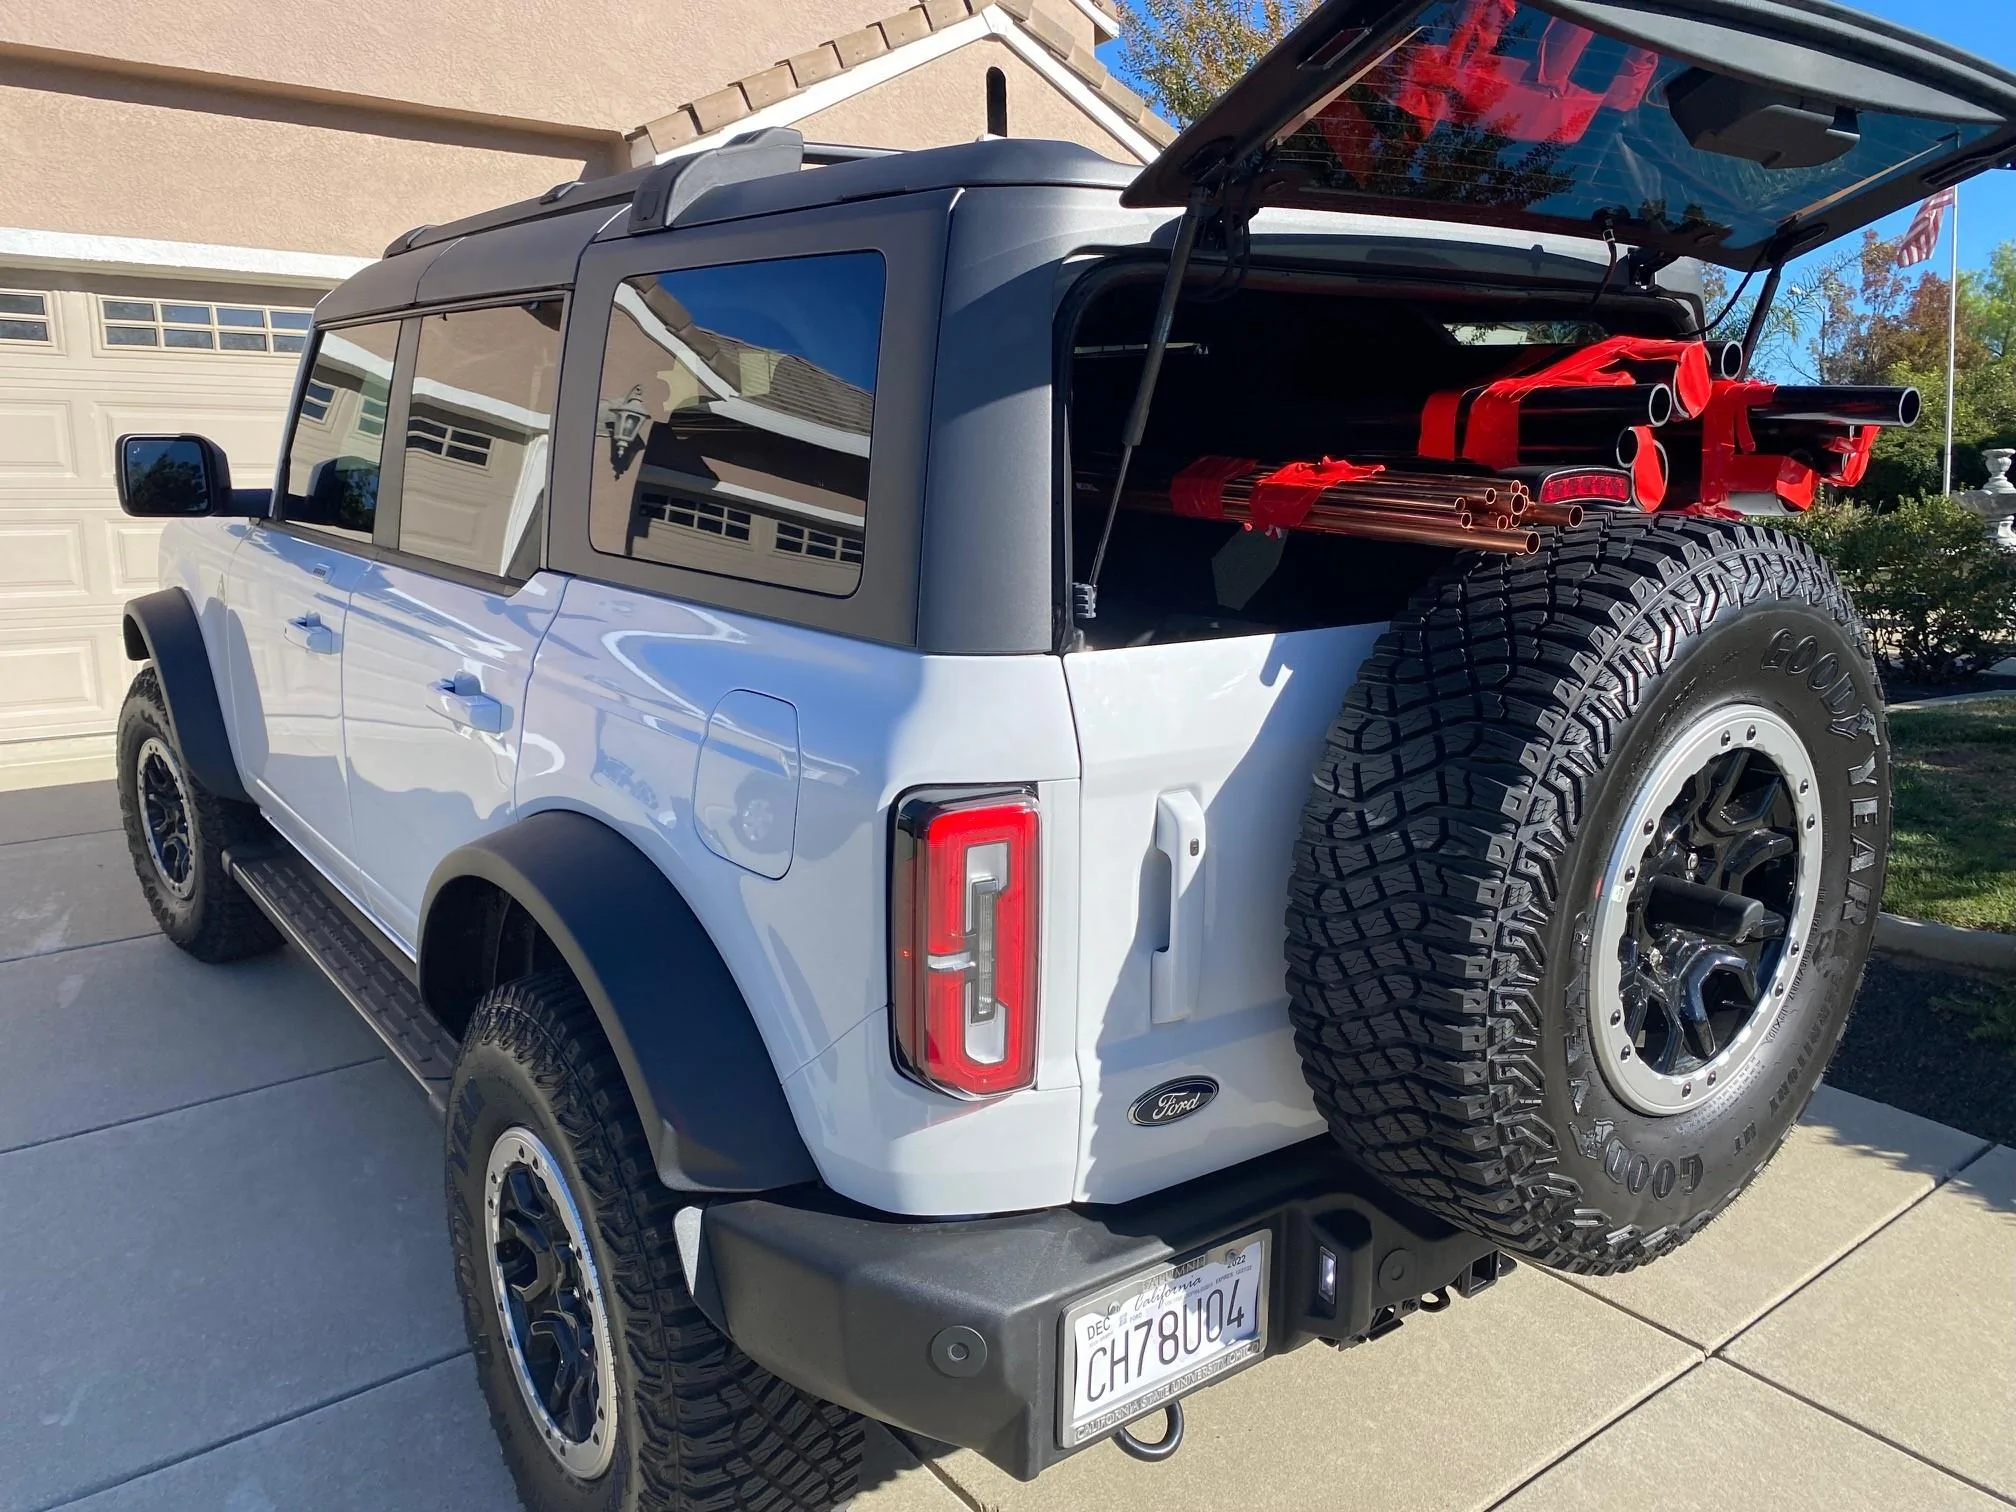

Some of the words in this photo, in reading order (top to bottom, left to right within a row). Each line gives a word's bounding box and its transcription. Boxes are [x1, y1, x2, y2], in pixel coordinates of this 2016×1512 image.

[1761, 627, 1881, 925] GOODYEAR
[1152, 1091, 1201, 1120] Ford
[1135, 1276, 1201, 1311] California
[1087, 1317, 1111, 1341] DEC
[1087, 1279, 1245, 1402] CH78U04
